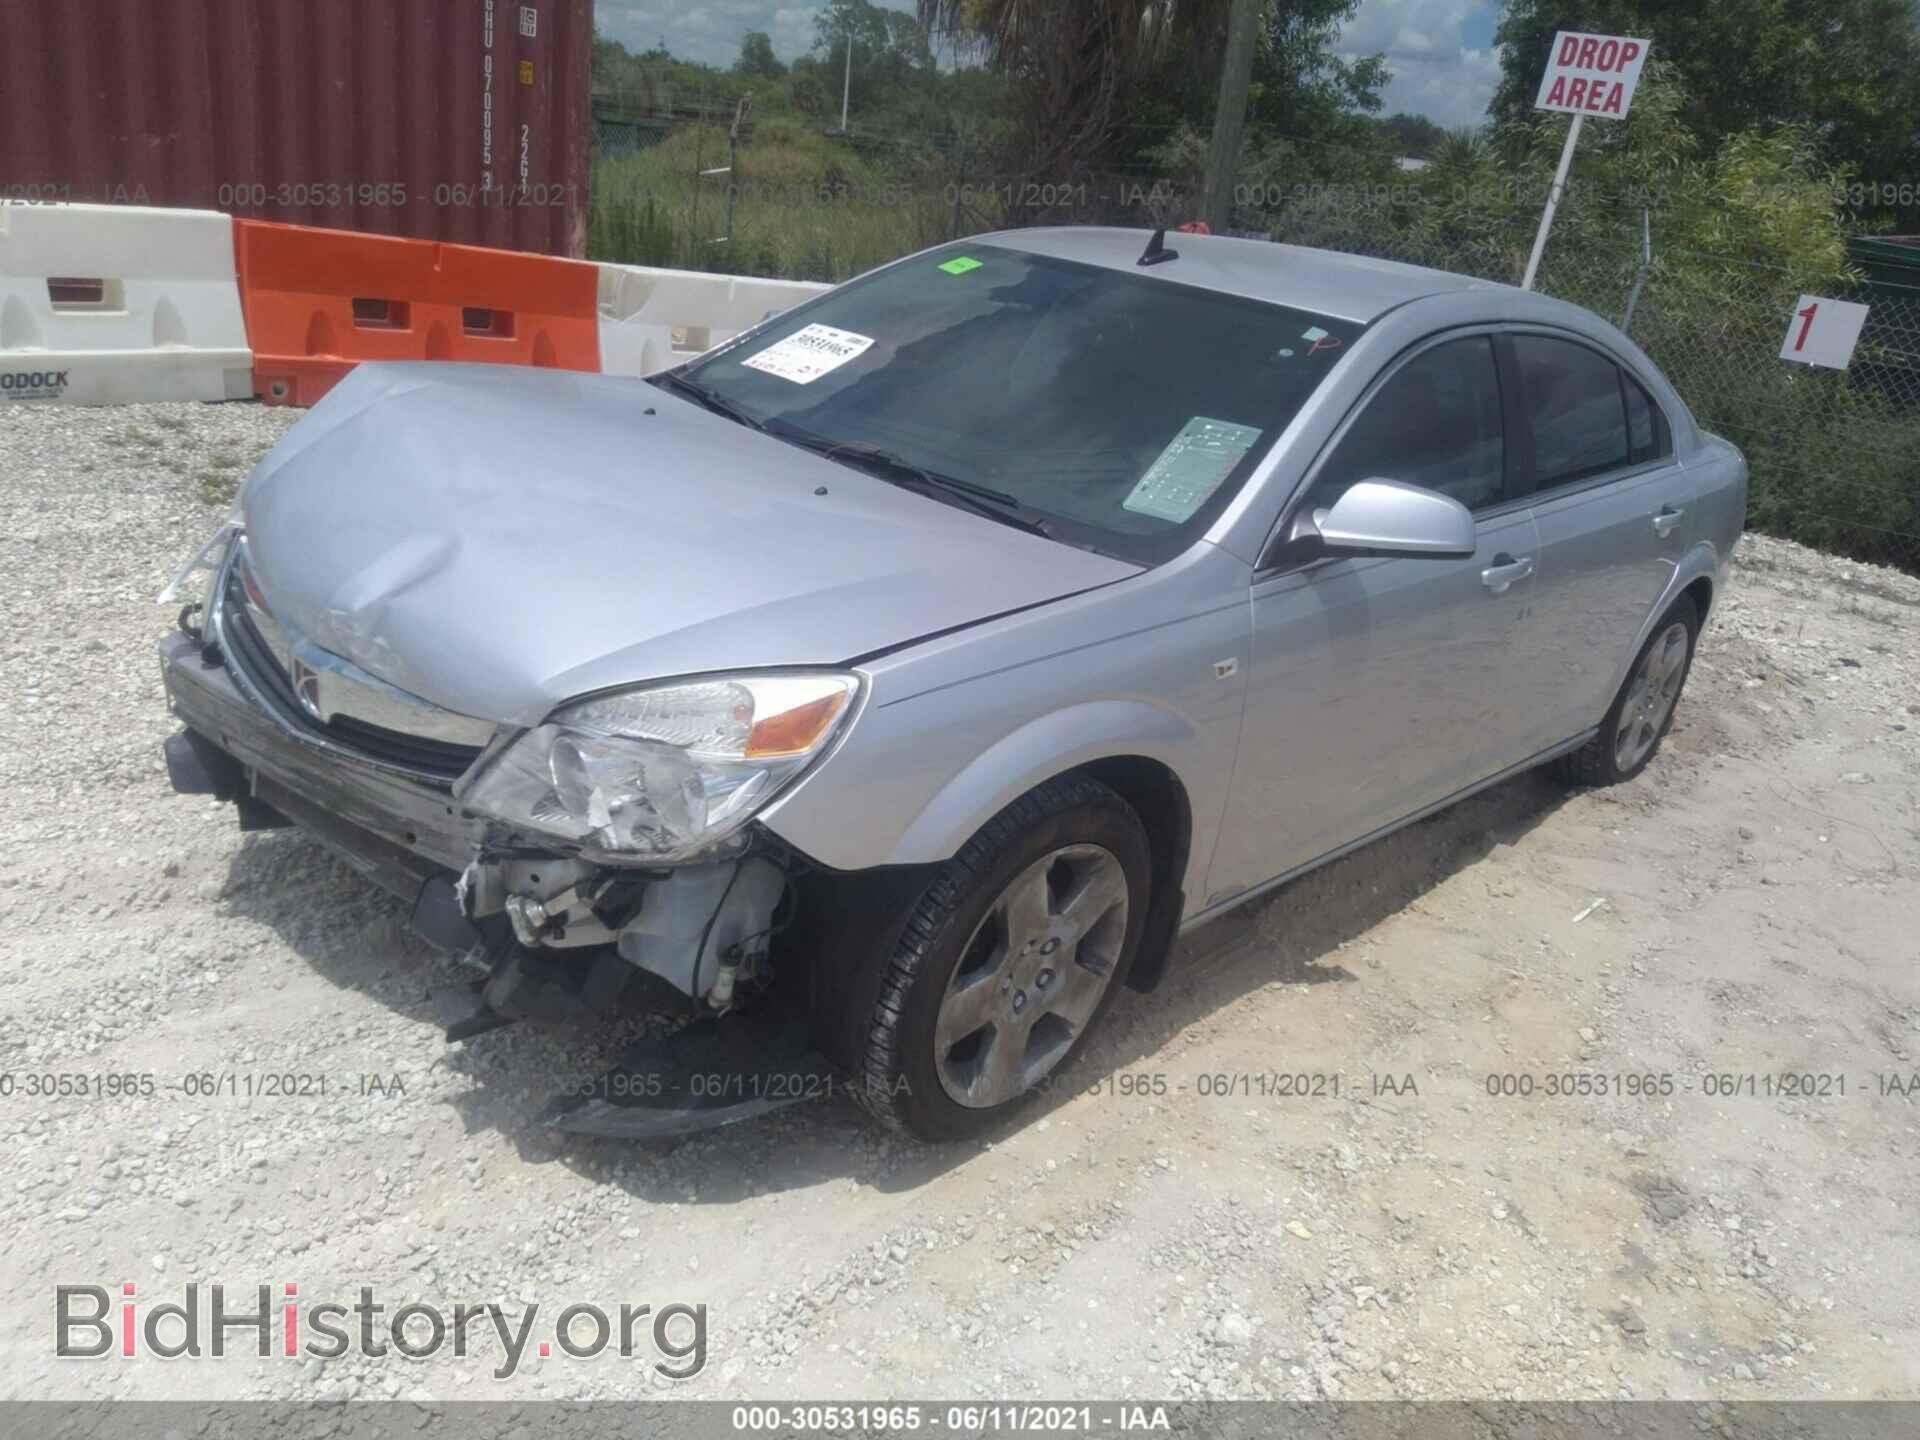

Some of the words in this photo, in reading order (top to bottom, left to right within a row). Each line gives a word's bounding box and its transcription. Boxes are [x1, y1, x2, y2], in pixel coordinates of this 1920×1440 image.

[1557, 36, 1640, 73] DROP
[483, 55, 493, 164] 070095
[1545, 76, 1624, 113] AREA
[1794, 303, 1818, 352] 1
